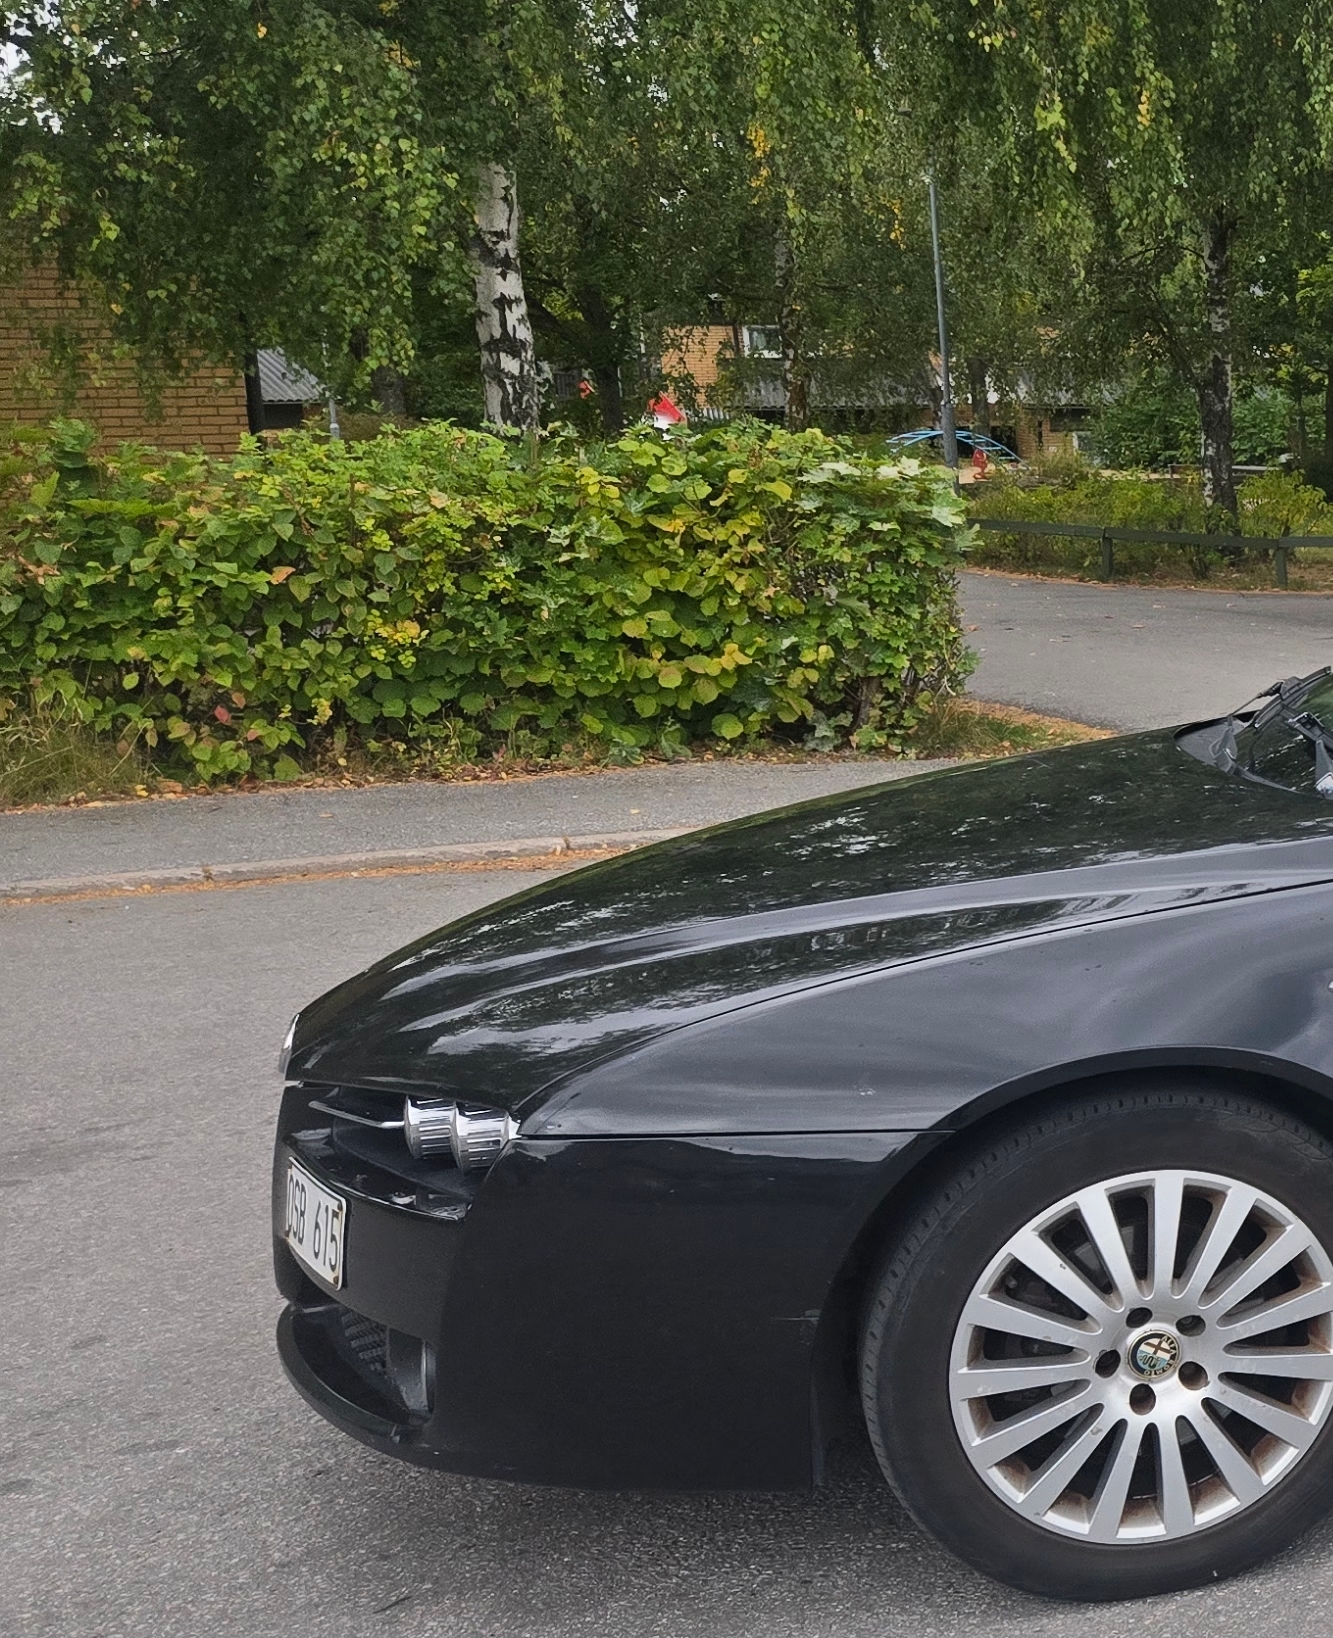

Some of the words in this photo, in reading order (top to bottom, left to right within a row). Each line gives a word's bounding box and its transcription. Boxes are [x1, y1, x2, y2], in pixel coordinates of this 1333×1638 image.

[287, 1174, 306, 1245] OSB
[314, 1201, 339, 1272] 615
[1161, 1335, 1176, 1355] ALFA
